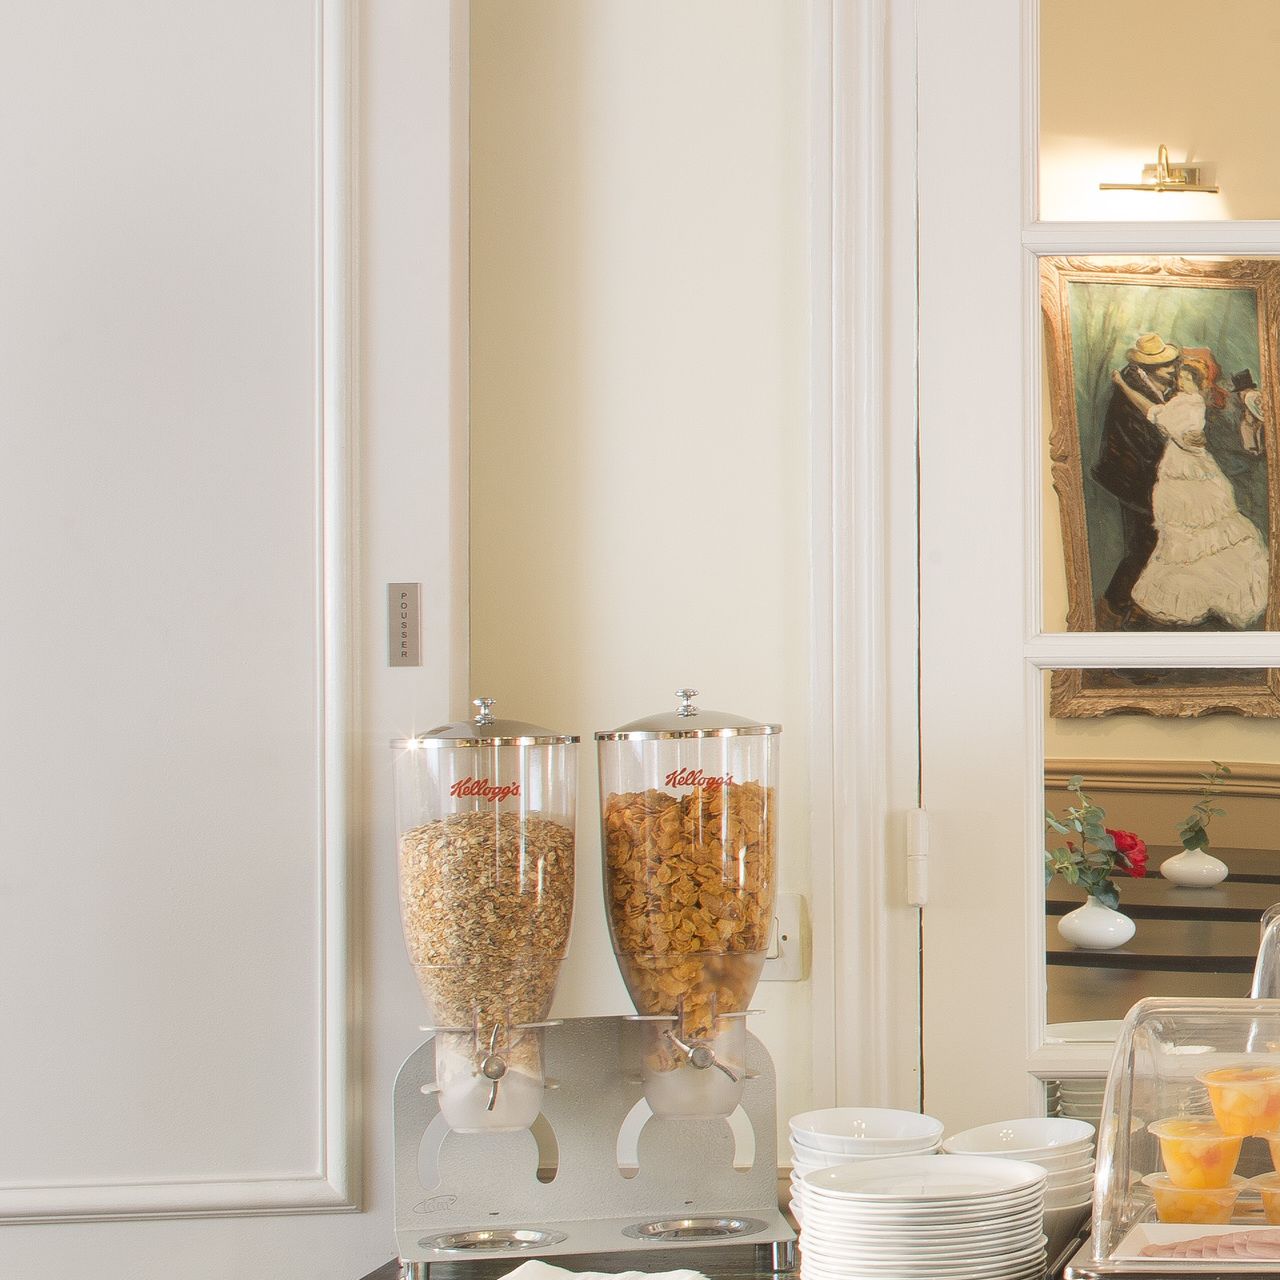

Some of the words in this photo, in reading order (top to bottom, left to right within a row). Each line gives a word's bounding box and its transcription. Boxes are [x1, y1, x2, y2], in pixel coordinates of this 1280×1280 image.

[400, 592, 408, 658] POUSSER
[450, 777, 520, 802] Kellogg's
[665, 767, 734, 792] Kellogg's
